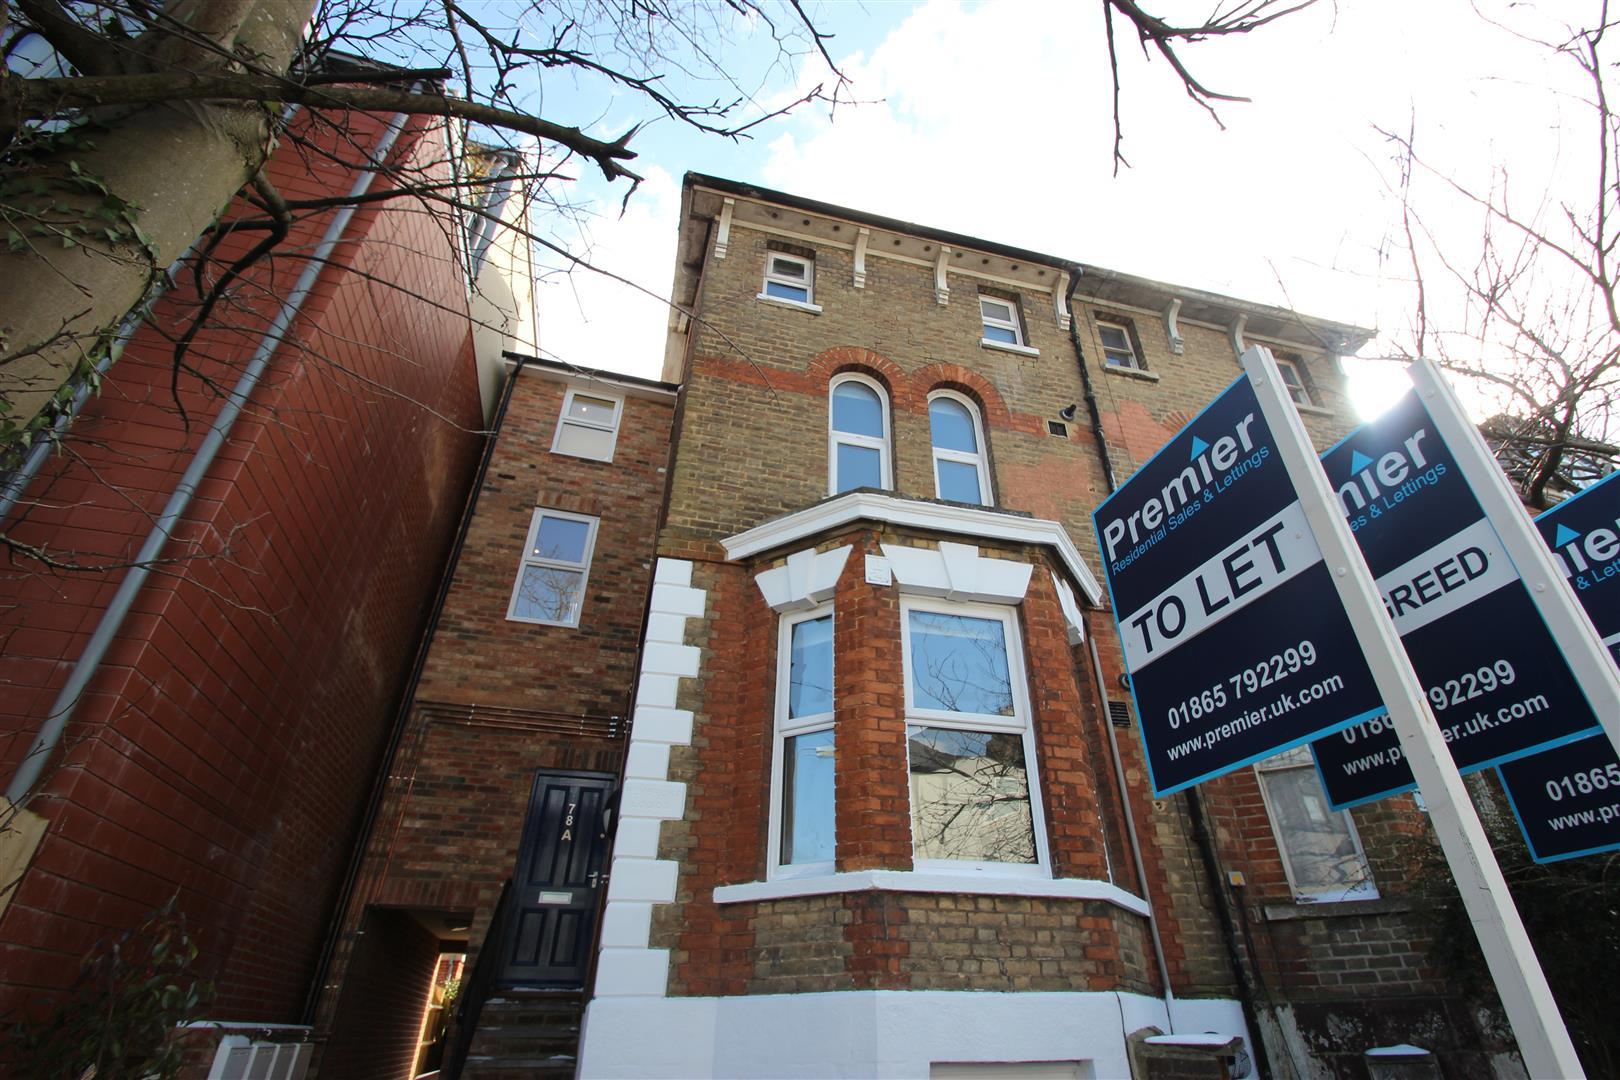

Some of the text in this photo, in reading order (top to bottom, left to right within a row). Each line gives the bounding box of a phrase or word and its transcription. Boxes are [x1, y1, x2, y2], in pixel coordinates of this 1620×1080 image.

[1103, 413, 1254, 562] Premier
[1112, 446, 1270, 576] Residential Sales & Lettings
[1335, 428, 1428, 518] mier
[1370, 462, 1447, 518] & Lettings
[1132, 521, 1286, 653] TO LET
[1382, 546, 1488, 620] REED
[1576, 576, 1591, 590] &
[1167, 674, 1344, 761] www.premier.uk.com
[1168, 640, 1317, 729] 01865 792299
[1424, 659, 1516, 711] 92299
[1545, 763, 1620, 801] 01865
